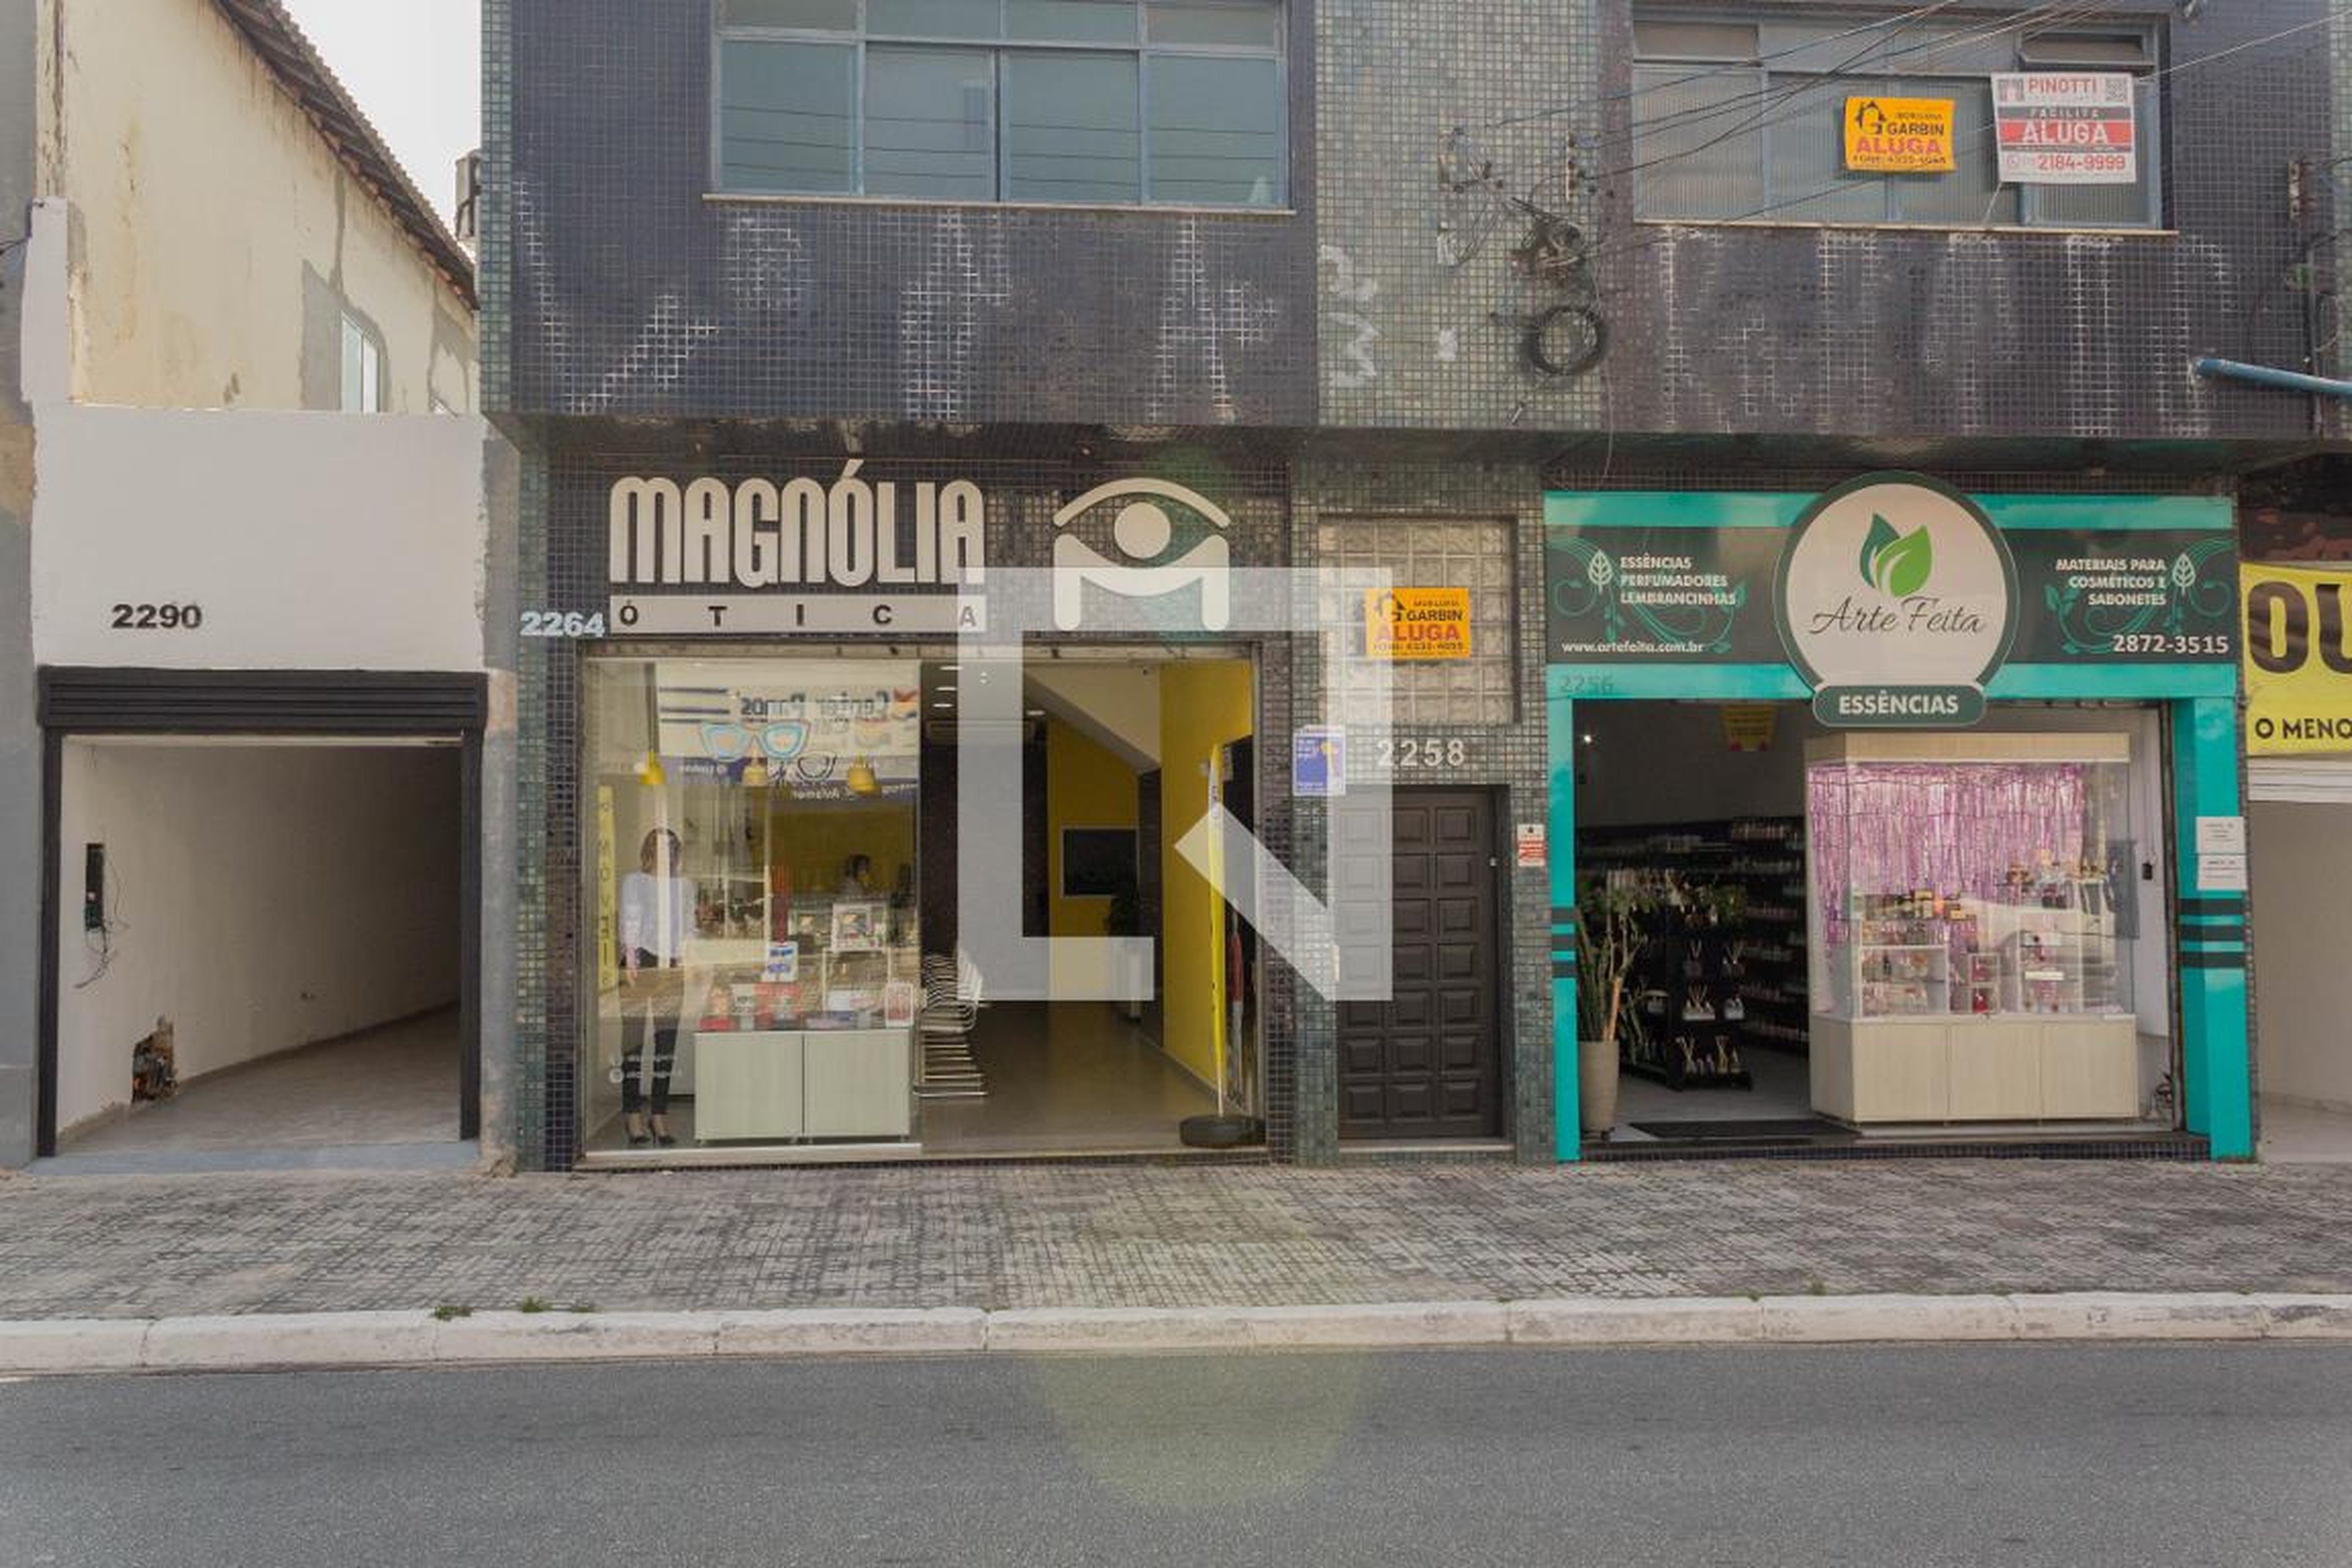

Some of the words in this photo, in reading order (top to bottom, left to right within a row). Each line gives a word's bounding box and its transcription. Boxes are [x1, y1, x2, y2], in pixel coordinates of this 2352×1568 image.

[2027, 77, 2097, 93] PINOTTI
[1887, 122, 1945, 135] GARBIN
[2022, 120, 2109, 144] ALUGA
[1856, 137, 1943, 156] ALUGA
[610, 459, 984, 588] MAGNÓLIA
[1620, 552, 1692, 568] ESSÊNCIAS
[2056, 559, 2127, 571] MATERIAIS
[2130, 559, 2167, 571] PARA
[1621, 575, 1728, 587] PERFUMADORES
[2068, 574, 2155, 589] COSMÉTICOS
[2087, 593, 2167, 606] SABONETES
[111, 603, 203, 629] 2290
[520, 611, 605, 638] 2264
[1406, 609, 1463, 622] GARBIN
[1809, 596, 1899, 635] Arte
[1901, 595, 1988, 633] Feita
[1374, 624, 1461, 641] ALUGA
[2113, 634, 2230, 654] 2872-3515
[1838, 690, 1959, 715] ESSÊNCIAS
[2255, 718, 2275, 739] O
[1377, 739, 1464, 767] 2258
